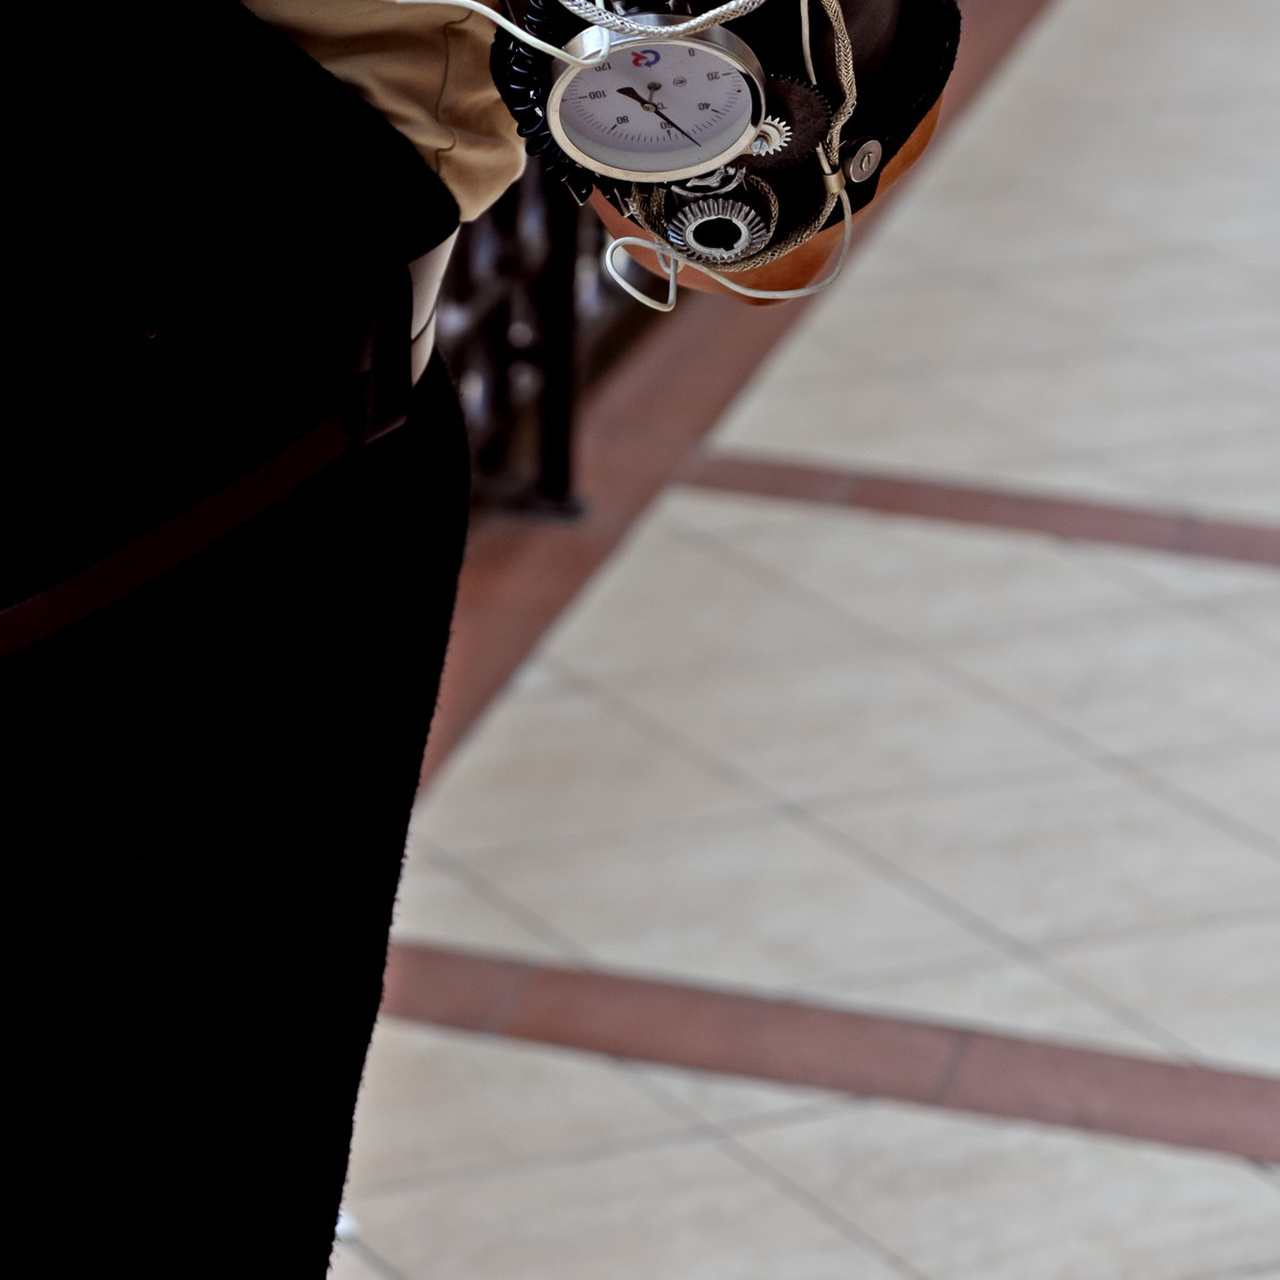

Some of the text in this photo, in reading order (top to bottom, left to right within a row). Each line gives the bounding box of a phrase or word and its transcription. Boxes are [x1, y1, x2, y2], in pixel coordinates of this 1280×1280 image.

[706, 71, 720, 81] 20
[589, 90, 606, 100] 100
[698, 102, 711, 111] 40
[616, 115, 630, 125] 80
